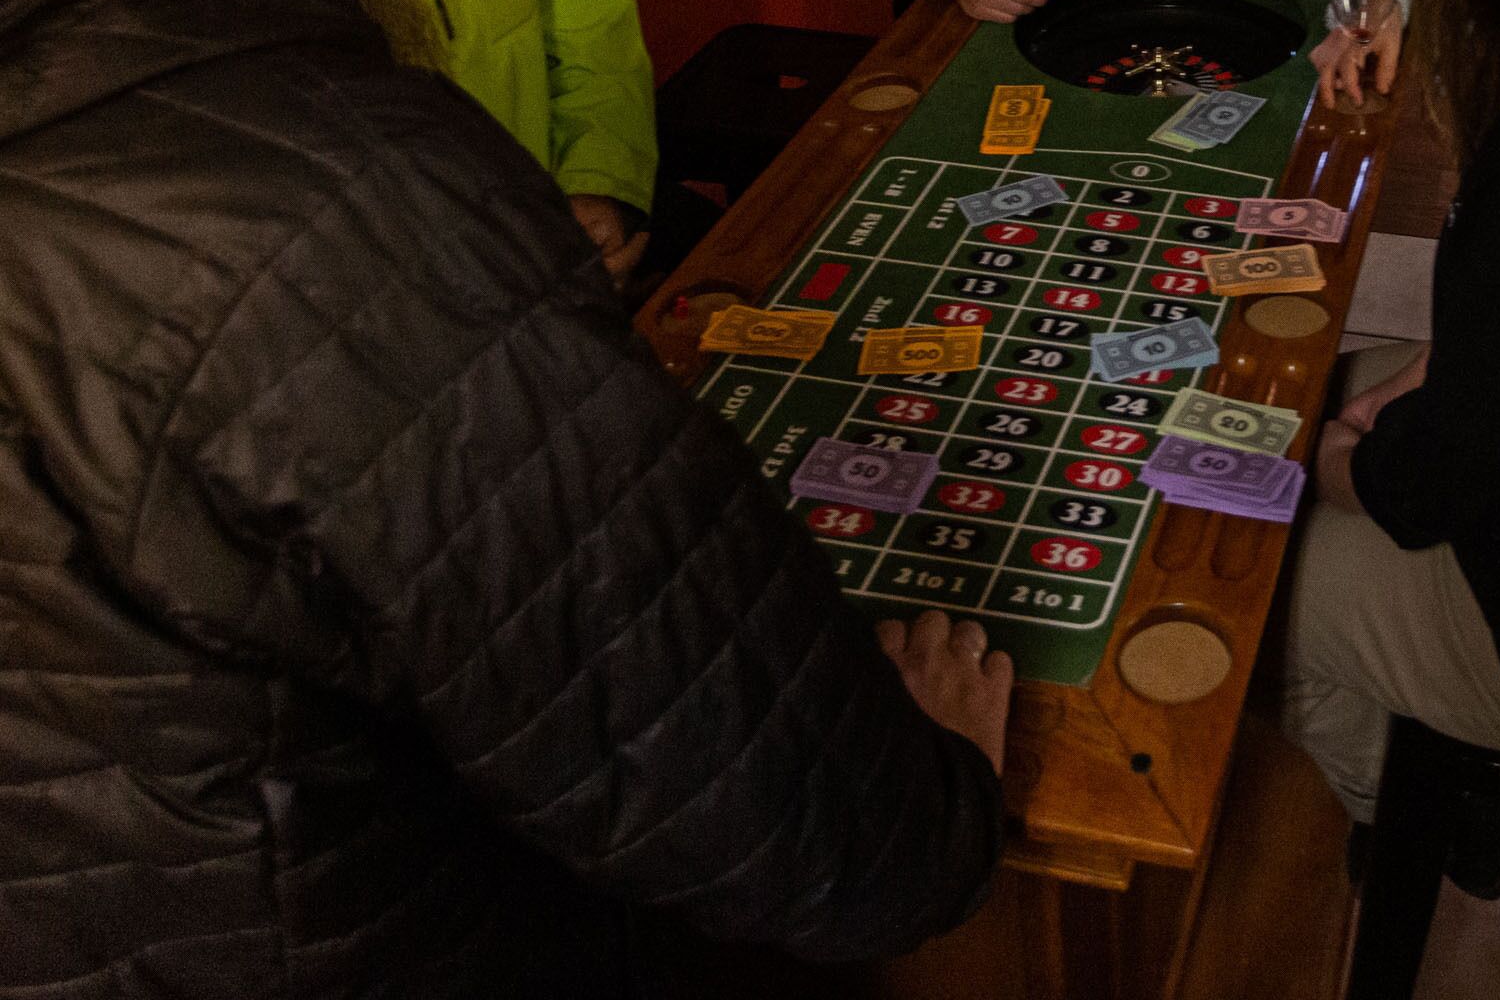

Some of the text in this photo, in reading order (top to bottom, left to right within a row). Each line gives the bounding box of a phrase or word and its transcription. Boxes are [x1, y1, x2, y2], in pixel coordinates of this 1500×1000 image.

[1131, 165, 1150, 178] 0
[1118, 189, 1136, 204] 2
[1204, 200, 1221, 214] 3
[1283, 211, 1295, 221] 5
[846, 212, 883, 247] EVEN
[1103, 213, 1123, 228] 5
[1001, 225, 1022, 240] 7
[1192, 224, 1212, 239] 6
[1090, 238, 1111, 253] 8
[978, 252, 1014, 268] 10
[1184, 250, 1202, 265] 9
[1067, 263, 1106, 280] 11
[1244, 261, 1278, 274] 100
[961, 277, 998, 295] 13
[1161, 275, 1197, 293] 12
[1053, 290, 1090, 308] 14
[862, 296, 894, 323] 2nd
[944, 306, 983, 323] 16
[1151, 302, 1190, 322] 15
[1039, 318, 1080, 336] 17
[903, 348, 939, 361] 500
[1143, 341, 1165, 356] 10
[1019, 348, 1063, 368] 20
[1004, 380, 1049, 401] 23
[884, 399, 930, 420] 25
[1105, 394, 1149, 416] 24
[985, 414, 1030, 436] 26
[1220, 415, 1249, 432] 20
[773, 424, 808, 455] 3rd
[1088, 429, 1138, 451] 27
[968, 448, 1014, 471] 29
[1199, 456, 1229, 470] 50
[849, 461, 880, 478] 50
[1076, 464, 1122, 488] 30
[949, 486, 991, 510] 32
[816, 508, 862, 534] 34
[1060, 502, 1106, 527] 33
[928, 525, 976, 550] 35
[1043, 543, 1089, 569] 36
[835, 559, 853, 575] 1
[892, 567, 968, 593] 2 to 1
[1009, 585, 1085, 611] 2 to 1
